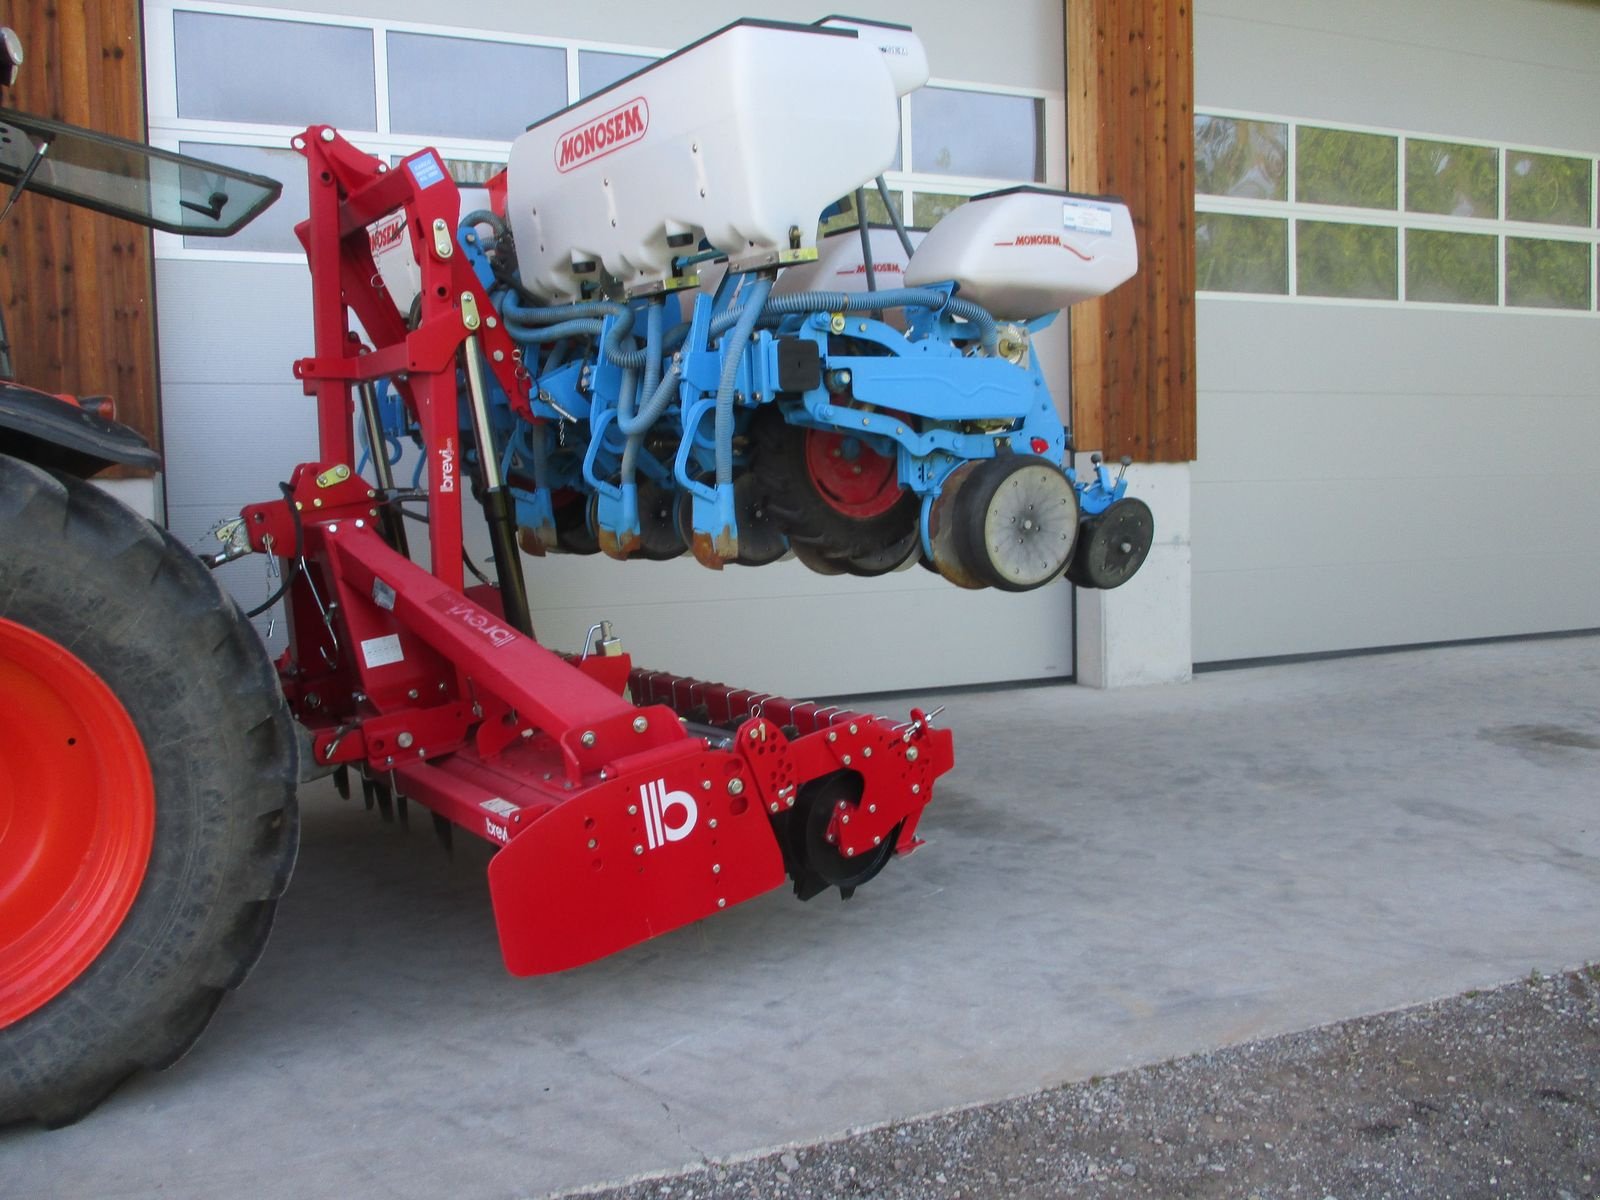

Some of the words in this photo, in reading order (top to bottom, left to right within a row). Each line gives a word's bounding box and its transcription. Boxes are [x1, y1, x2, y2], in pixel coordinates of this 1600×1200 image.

[560, 105, 643, 166] MONOSEM
[1015, 234, 1061, 246] MONOSEM
[856, 263, 900, 273] MNOSEM
[439, 449, 454, 492] brevi
[446, 606, 516, 648] brevi
